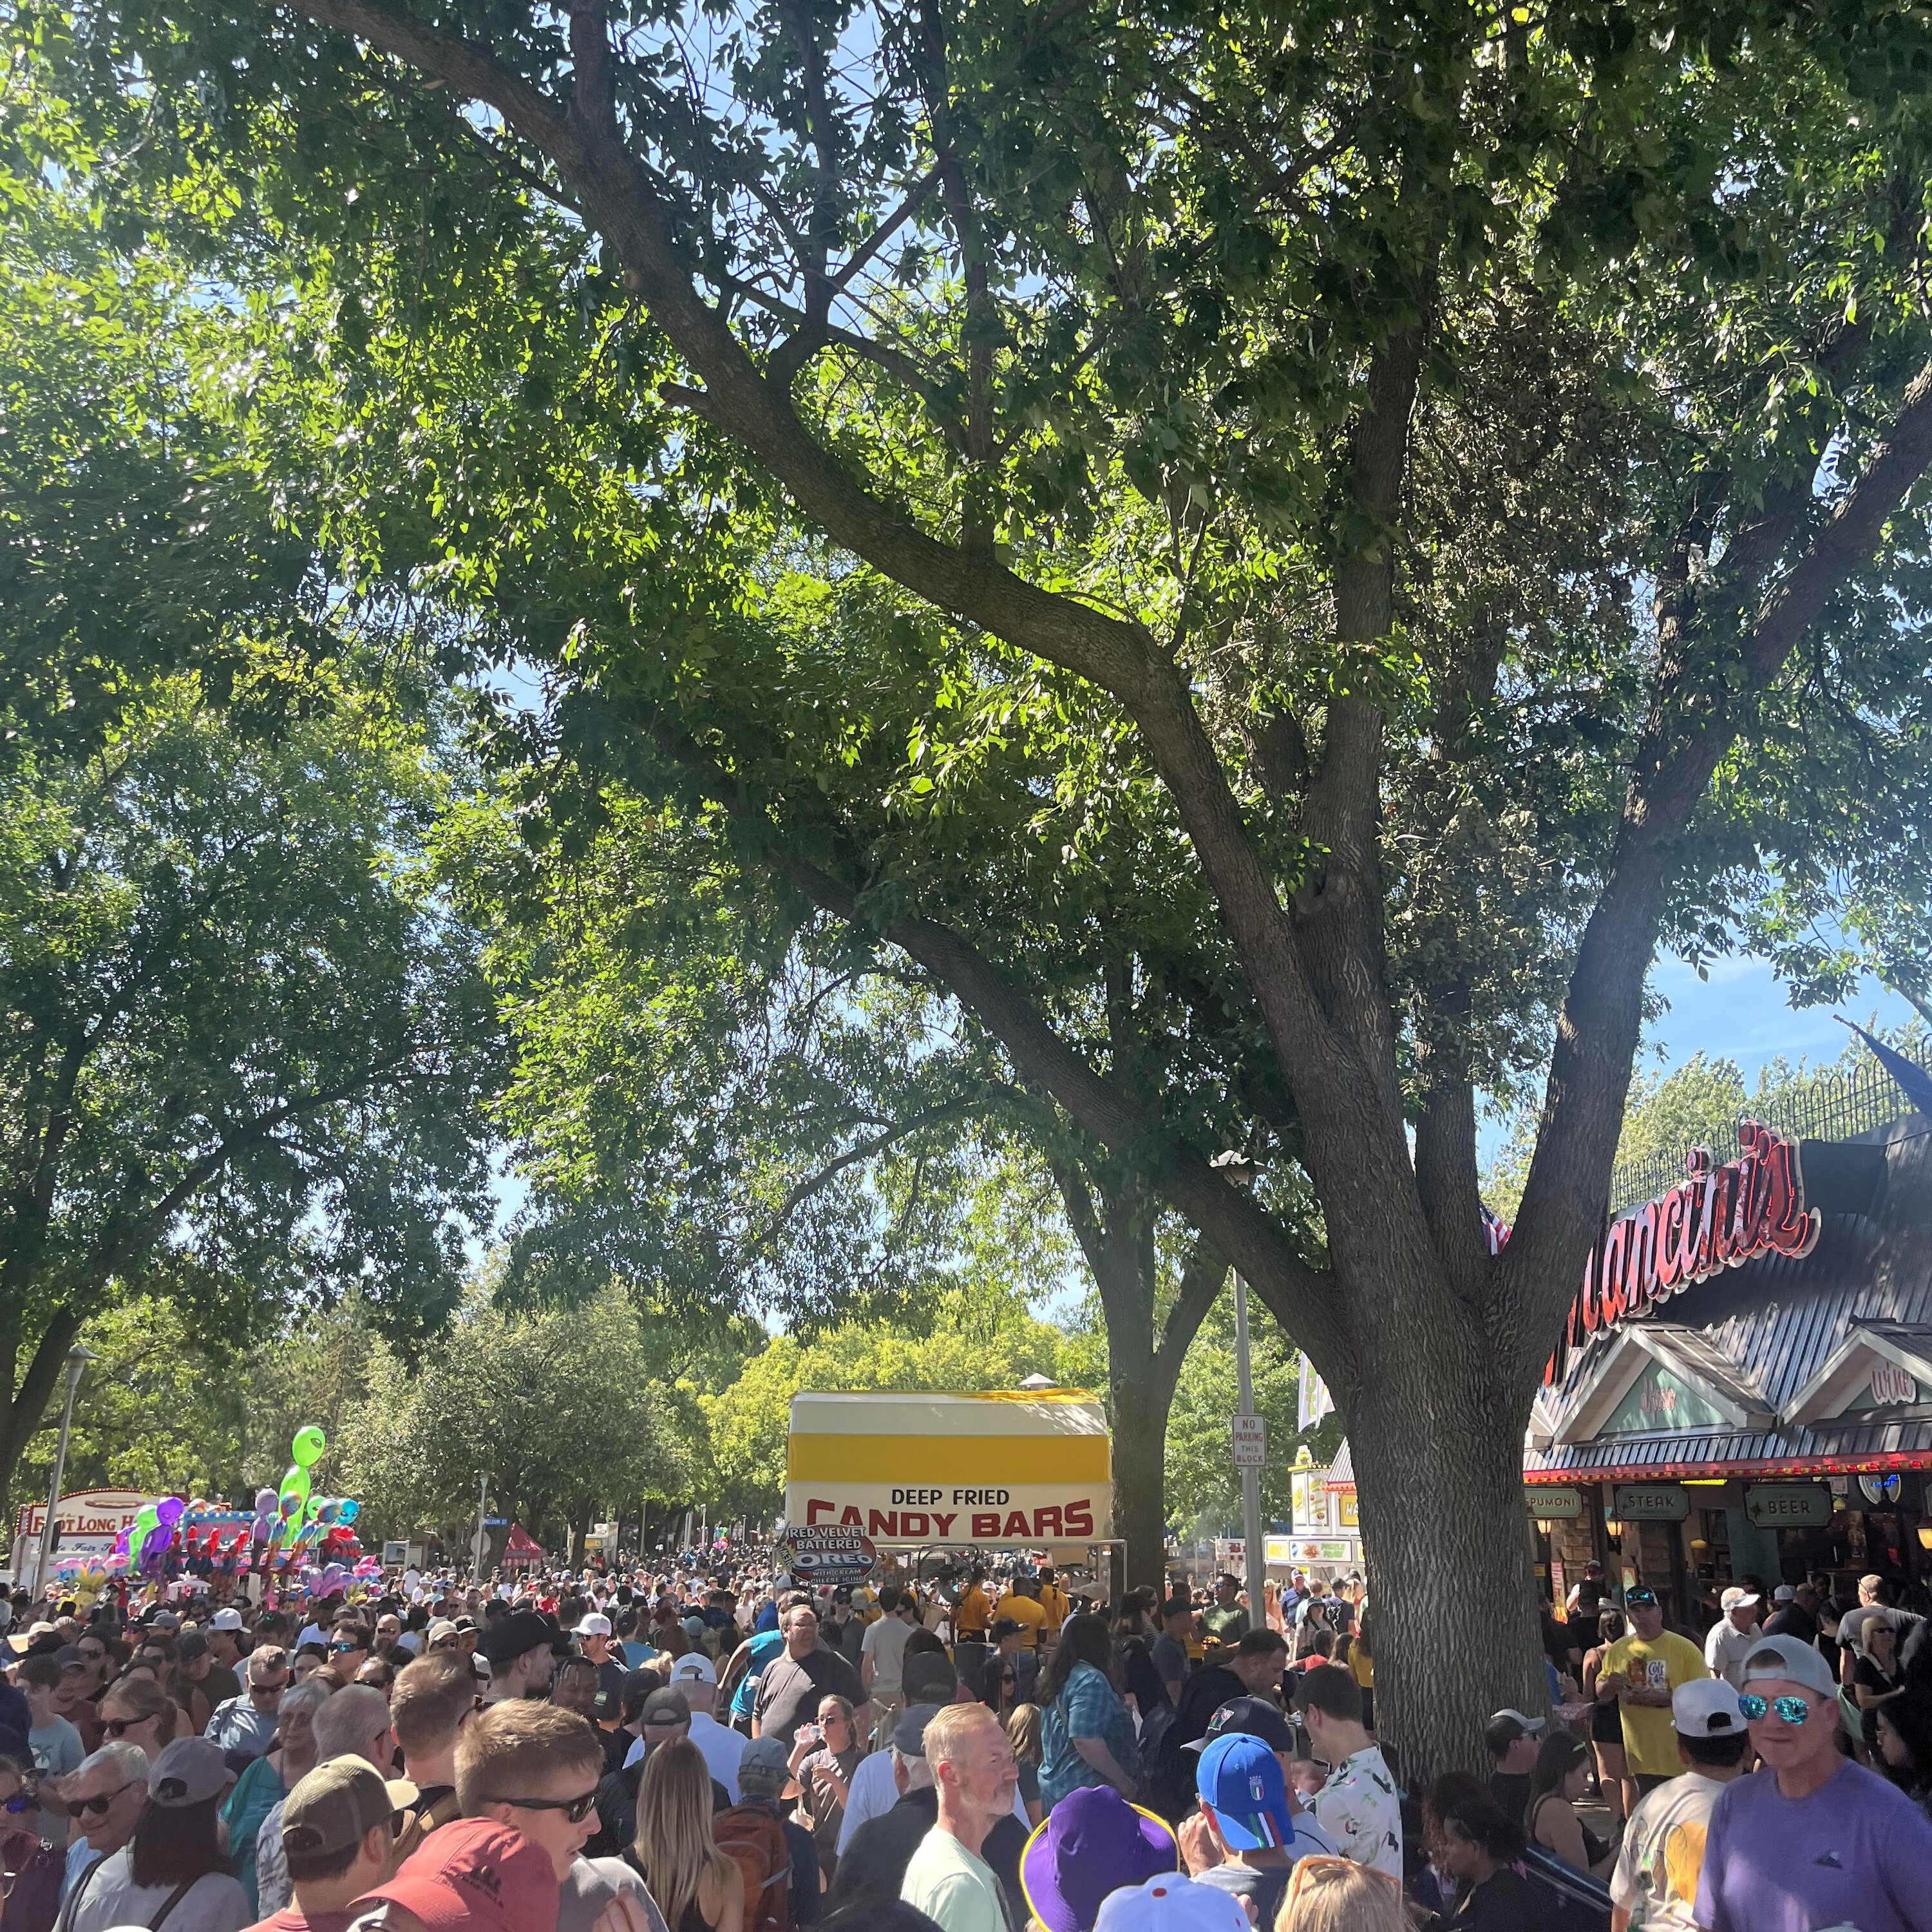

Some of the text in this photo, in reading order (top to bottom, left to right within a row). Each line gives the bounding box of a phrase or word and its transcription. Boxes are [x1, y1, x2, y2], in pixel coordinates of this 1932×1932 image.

[1242, 1419, 1255, 1429] NO
[1235, 1432, 1263, 1442] PARKING
[892, 1489, 1009, 1505] DEEP FRIED
[1525, 1497, 1575, 1506] SPUMONI
[1629, 1495, 1674, 1507] STEAK
[1768, 1501, 1811, 1513] BEER
[33, 1516, 75, 1531] FT
[77, 1515, 116, 1531] LONG
[807, 1499, 1093, 1537] CANDY BARS
[789, 1527, 866, 1538] RED VELVET
[796, 1539, 862, 1550] BATTERED
[795, 1553, 873, 1569] OREO
[1648, 1662, 1664, 1675] Colt
